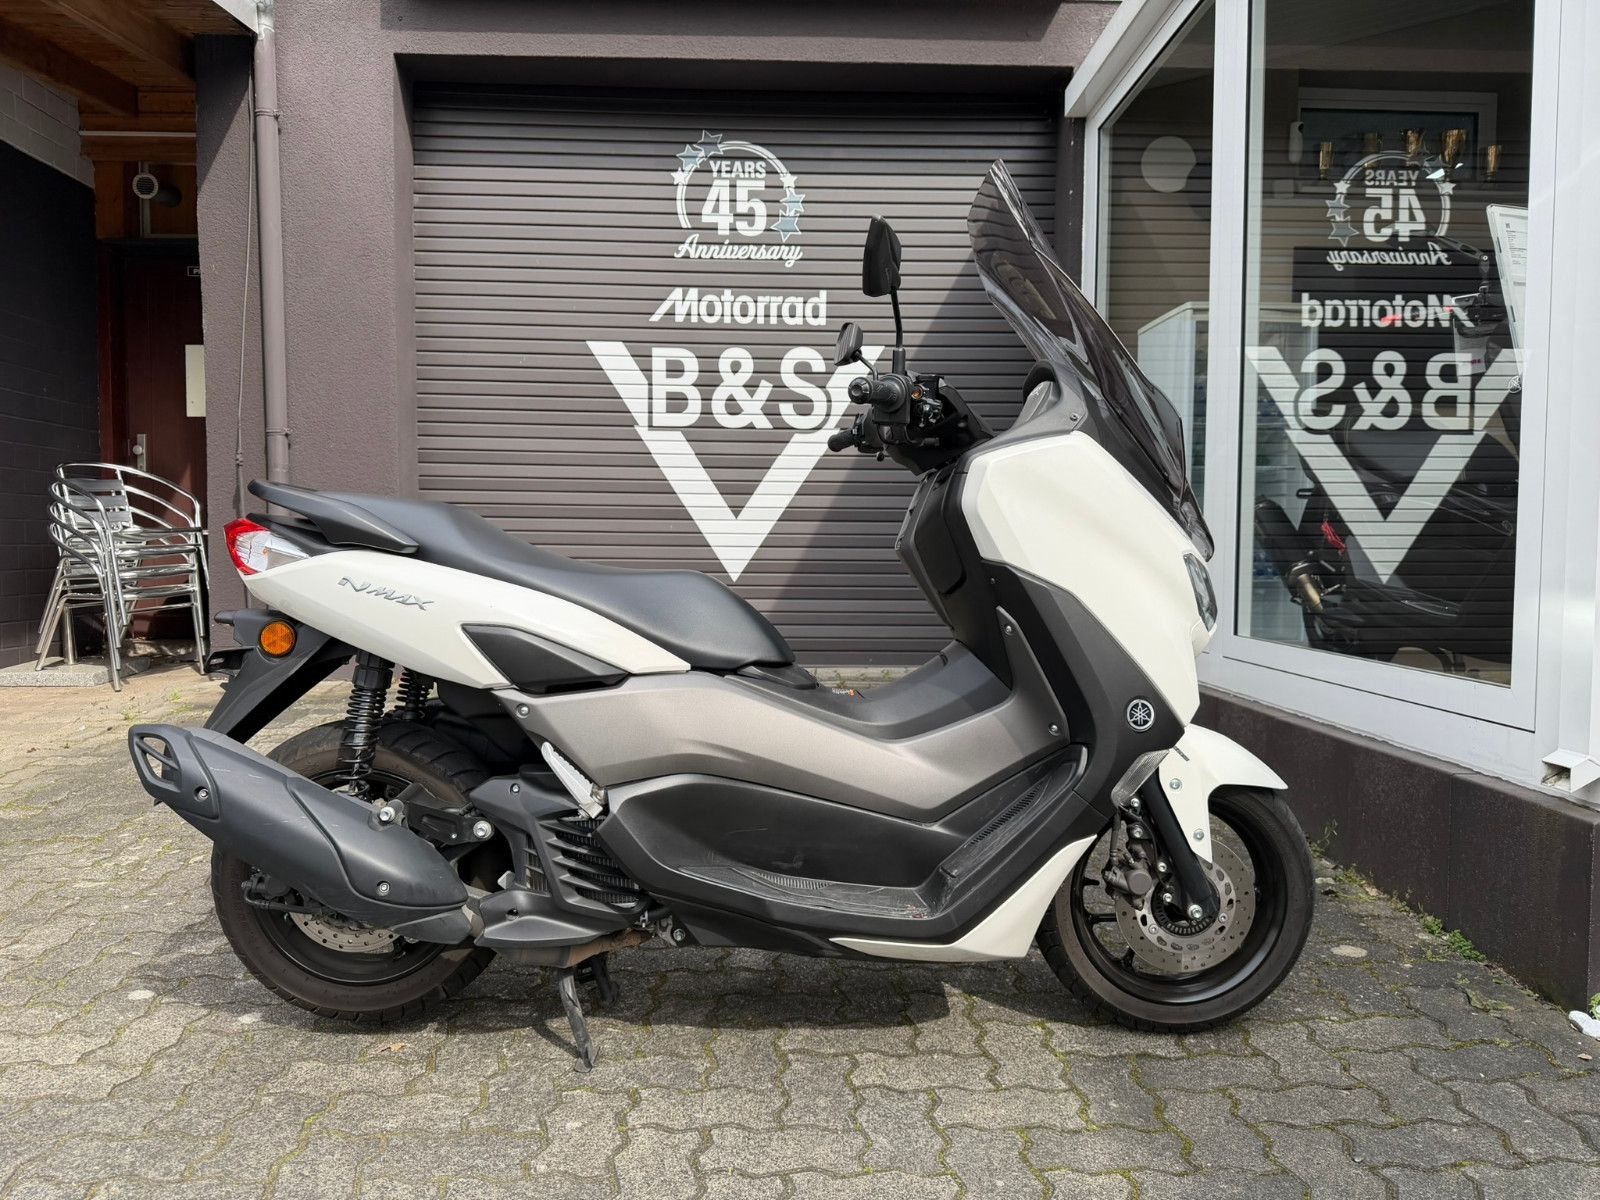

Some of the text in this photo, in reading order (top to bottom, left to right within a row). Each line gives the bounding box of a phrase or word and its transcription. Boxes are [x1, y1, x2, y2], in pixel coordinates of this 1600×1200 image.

[709, 160, 767, 179] YEARS
[701, 179, 767, 237] 45
[673, 233, 803, 268] Anniversary
[649, 287, 828, 326] Motorrad
[651, 346, 828, 430] B&S
[337, 576, 434, 611] NMAX
